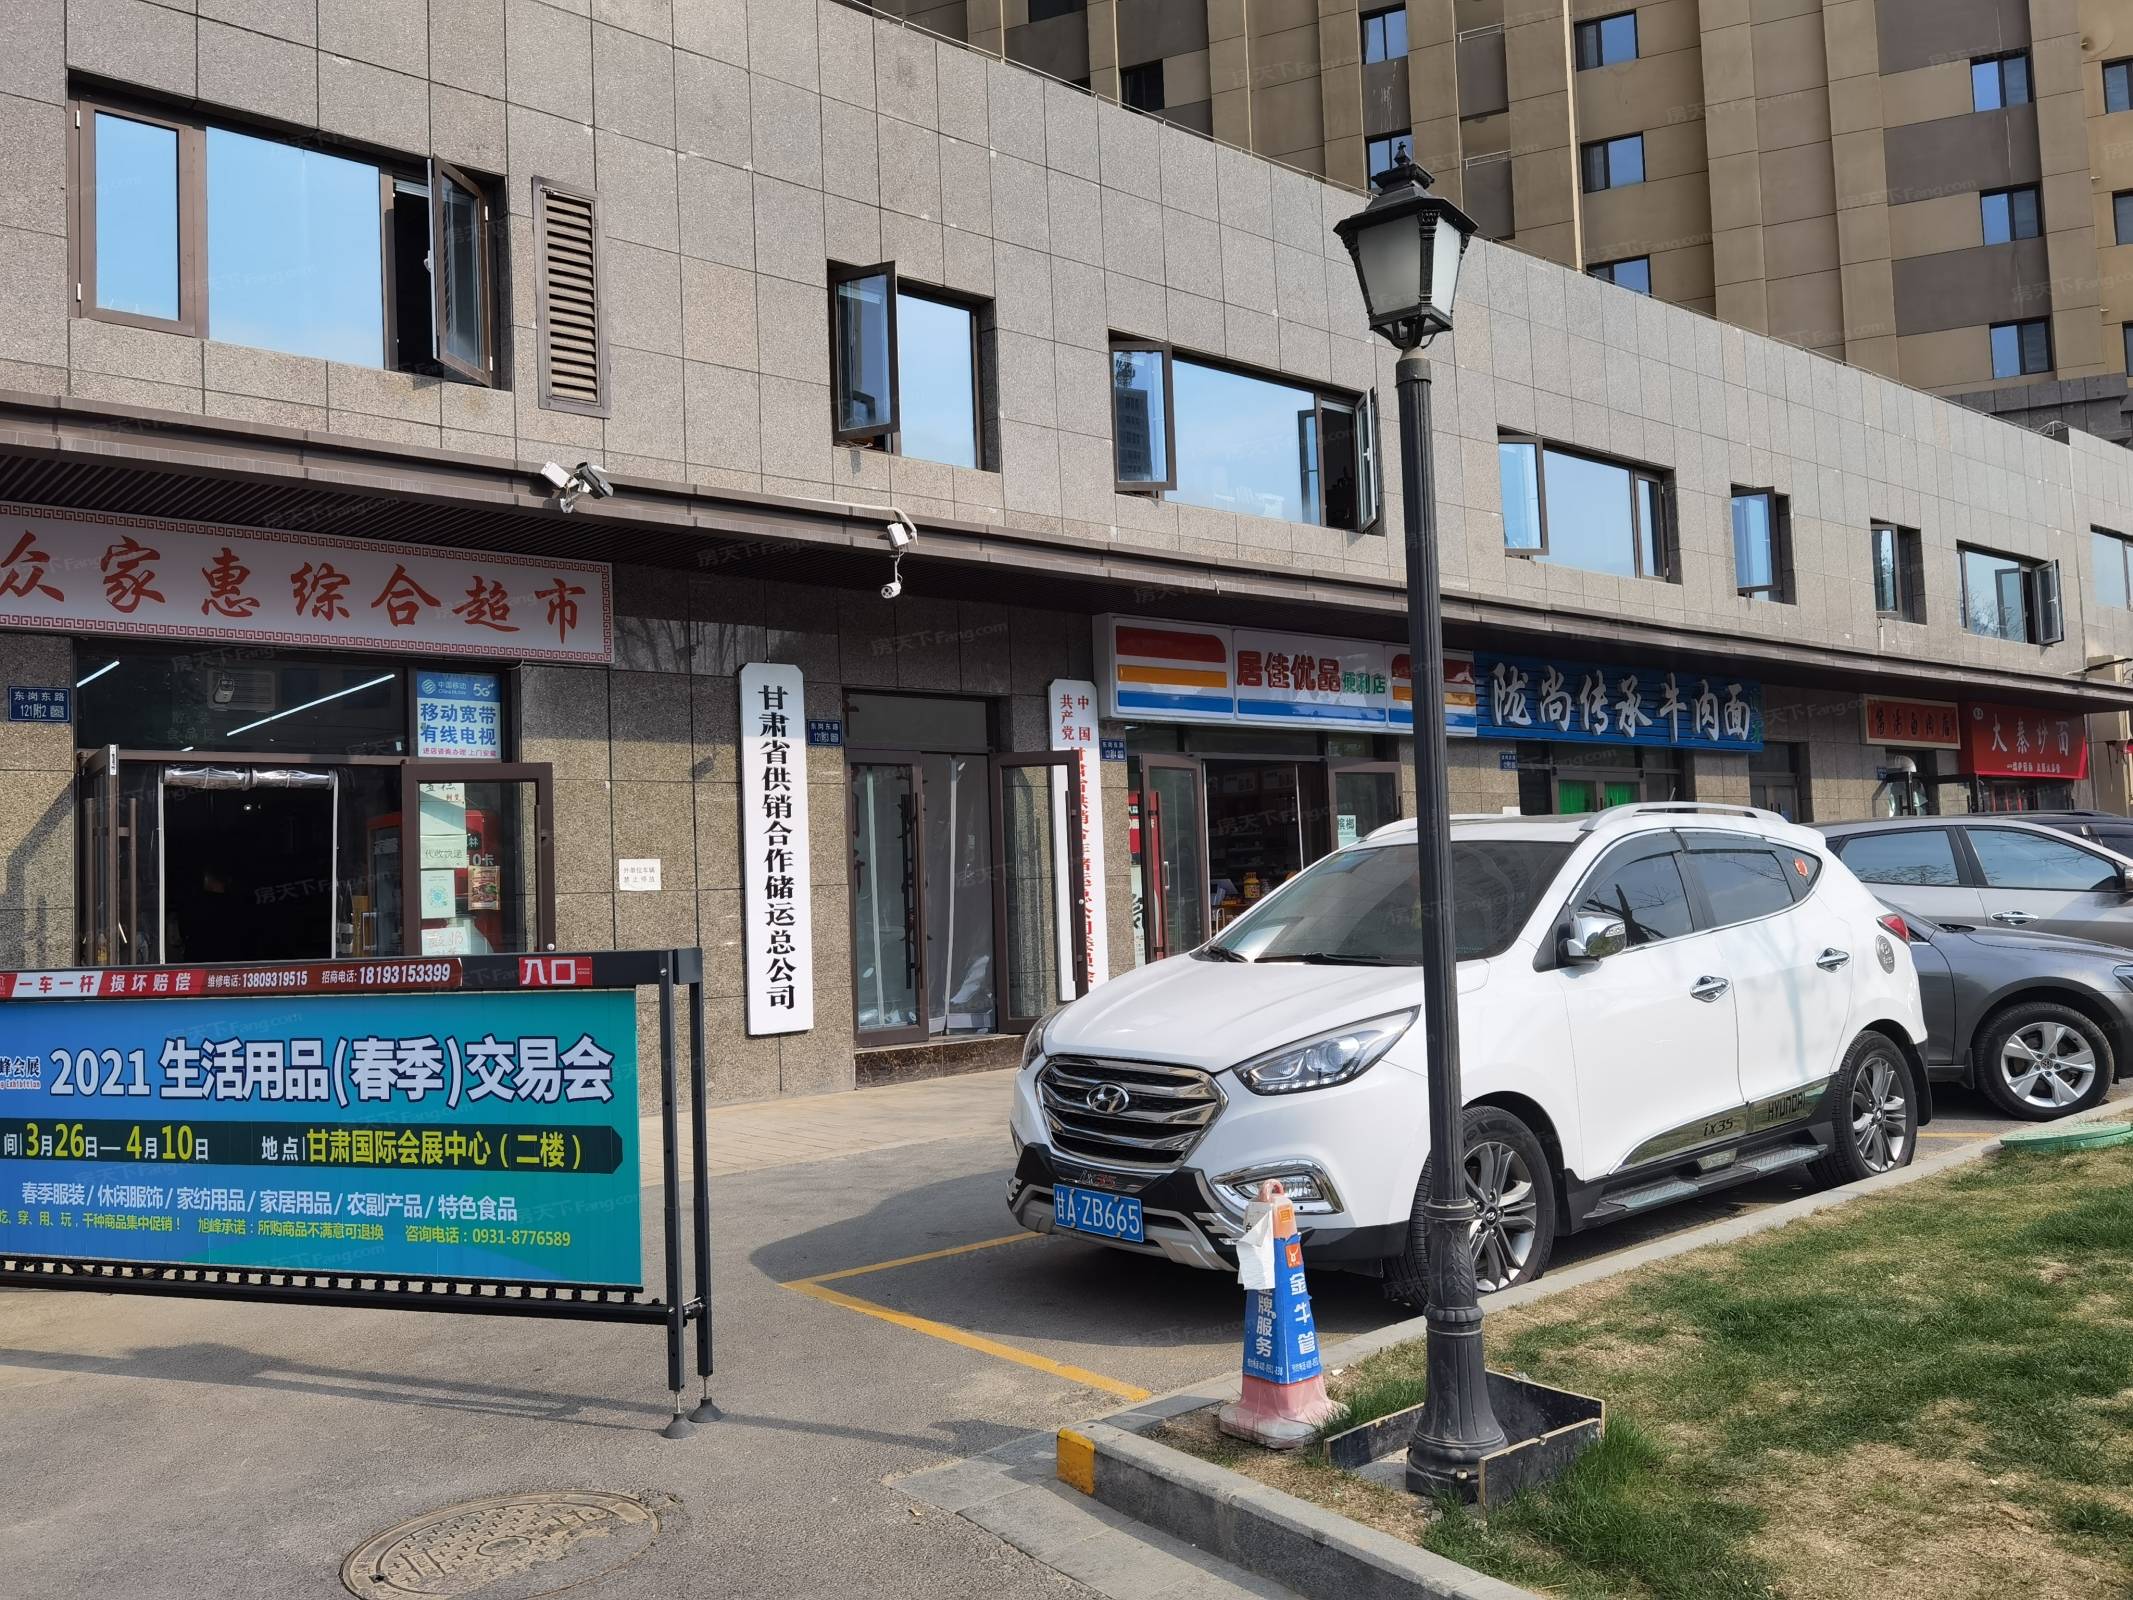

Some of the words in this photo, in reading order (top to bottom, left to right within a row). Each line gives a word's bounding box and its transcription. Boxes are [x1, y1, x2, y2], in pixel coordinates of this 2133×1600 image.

[0, 530, 586, 645] 众家惠综合超市
[1342, 671, 1387, 695] 便利店
[14, 690, 65, 702] 东岗东路
[1493, 661, 1751, 744] 陇尚传承牛肉面
[420, 703, 497, 725] 移动宽带
[420, 724, 497, 746] 有线电视
[757, 685, 796, 1011] 甘肃省供销合作储运总公司
[18, 974, 96, 994] 一车一杆
[110, 971, 192, 993] 损坏赔偿
[521, 959, 576, 985] 入口
[49, 1049, 151, 1097] 2021
[159, 1033, 613, 1107] 生活用品(春季)交易会
[1703, 1117, 1734, 1137] ix35
